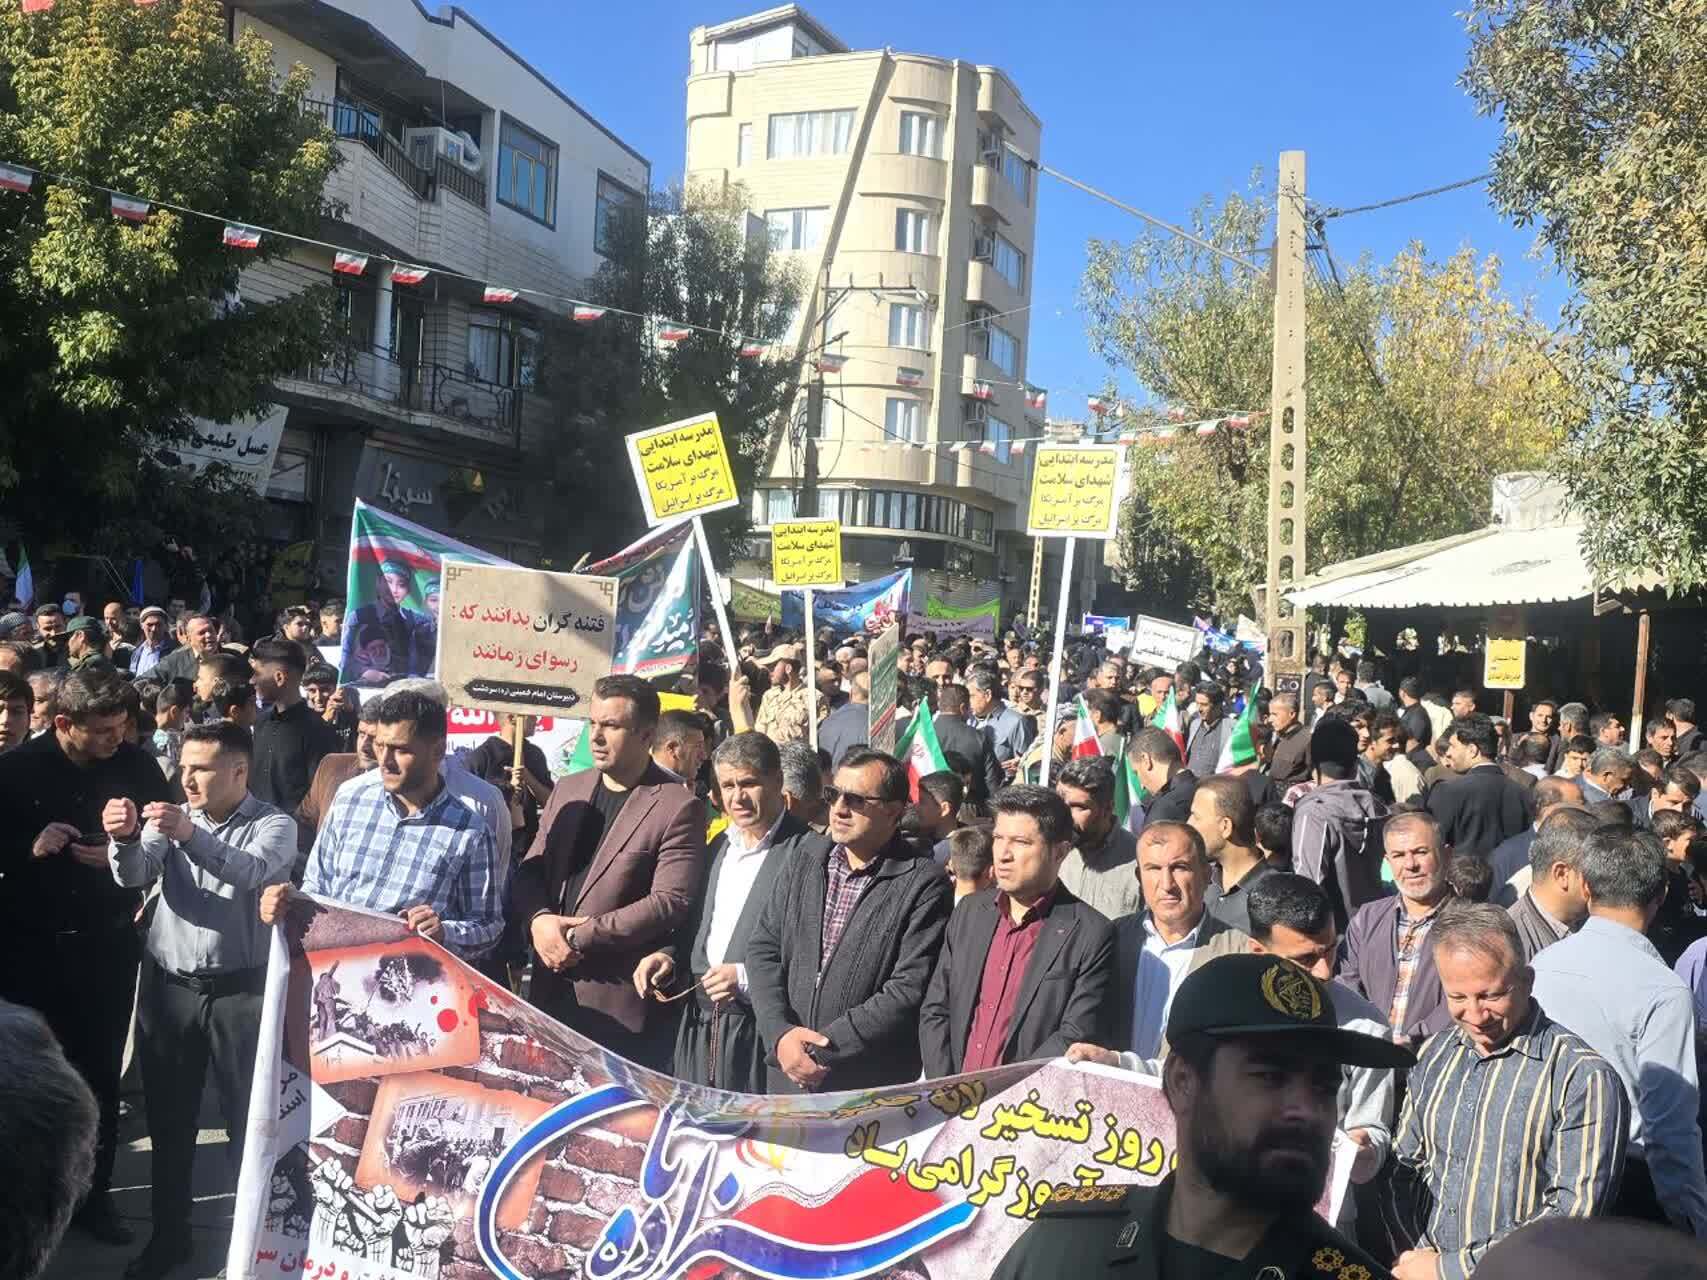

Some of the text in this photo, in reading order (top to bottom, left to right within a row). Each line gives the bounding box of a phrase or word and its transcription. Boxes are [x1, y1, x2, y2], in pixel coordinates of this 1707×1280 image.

[680, 426, 713, 442] مدرسه
[238, 436, 269, 457] عسل
[647, 444, 718, 473] شهدای سلامت
[1040, 473, 1112, 488] شهدای سلامت
[459, 604, 479, 620] که
[482, 606, 530, 630] بدانند
[574, 614, 606, 633] فتنه
[525, 650, 578, 672] رسوای
[982, 1088, 1093, 1143] تسخیر
[1094, 1112, 1164, 1176] روز
[906, 1143, 1015, 1206] گرامی
